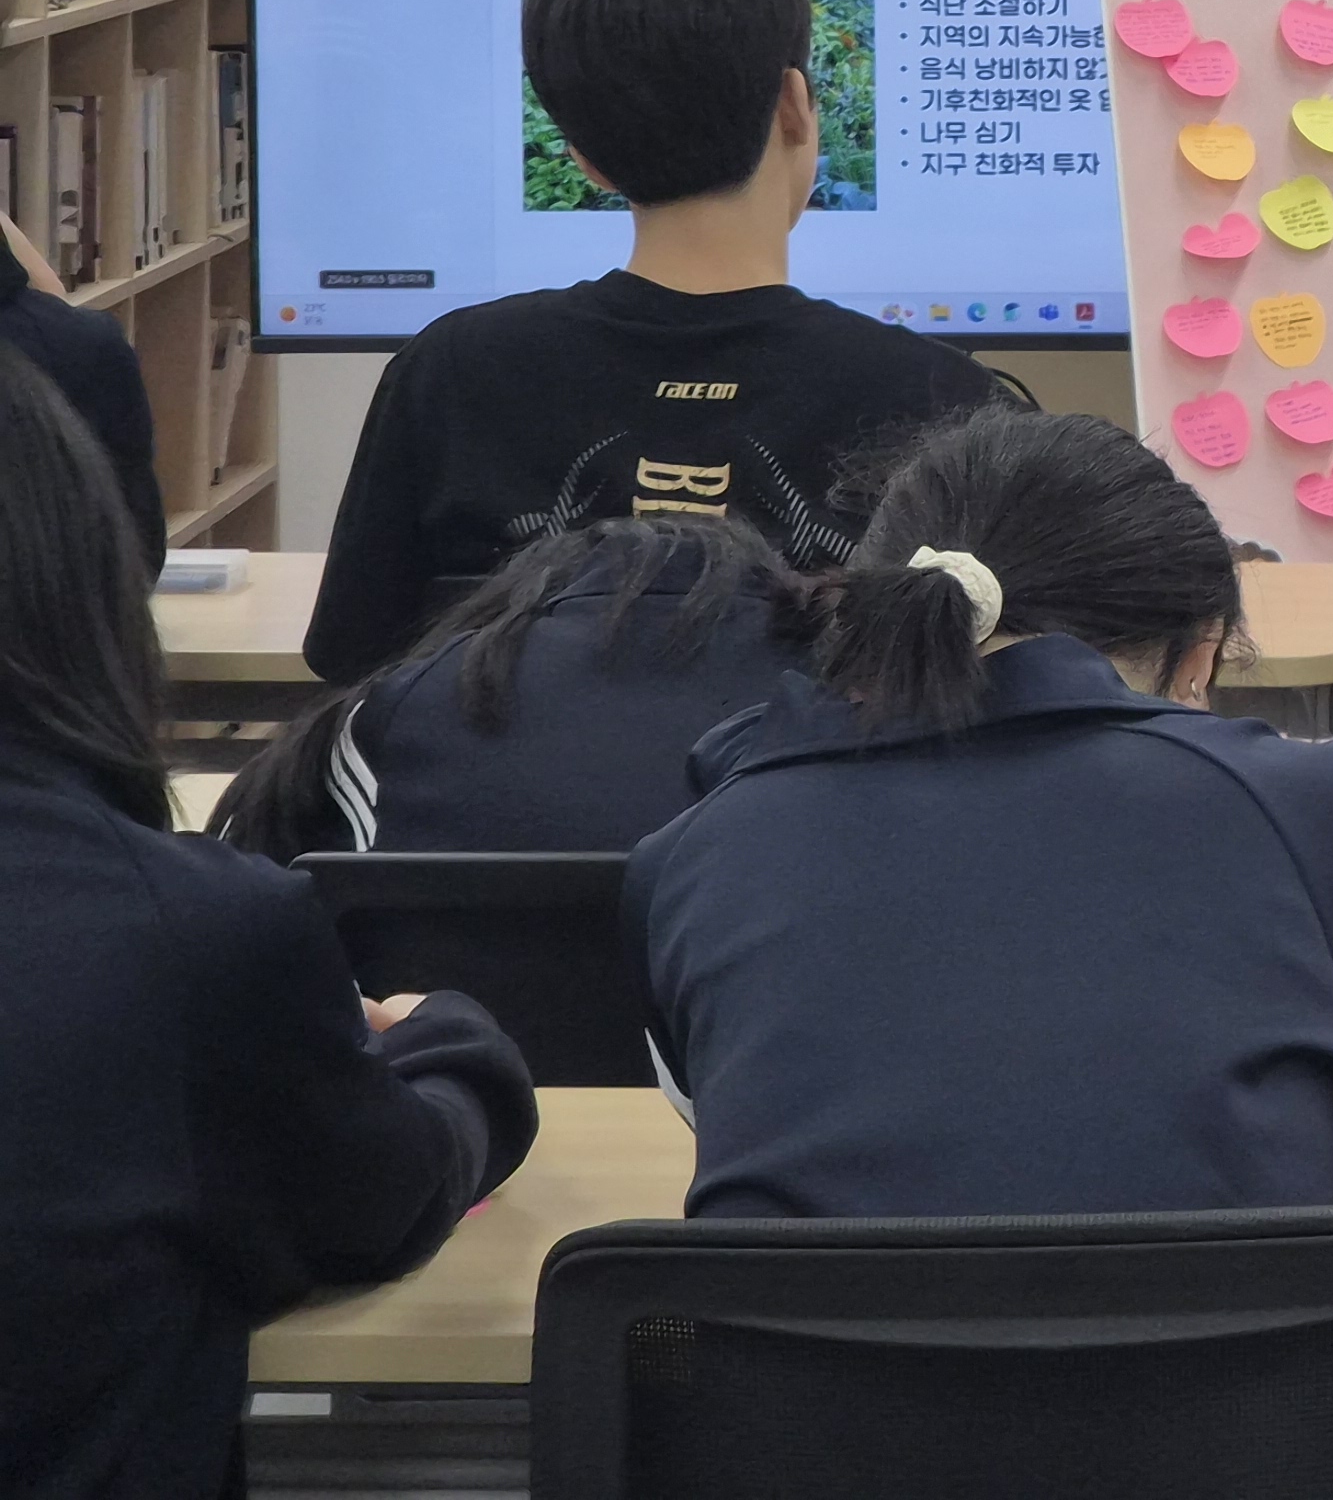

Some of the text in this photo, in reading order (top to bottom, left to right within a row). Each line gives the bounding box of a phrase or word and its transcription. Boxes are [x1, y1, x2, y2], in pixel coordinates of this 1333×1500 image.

[919, 25, 990, 48] 지역의
[920, 57, 966, 81] 음식
[974, 57, 1068, 81] 낭비하지
[920, 88, 1061, 112] 기후친화적인
[1068, 88, 1092, 112] 옷
[920, 121, 1021, 145] 나무 심기
[921, 152, 1100, 176] 지구 친화적 투자
